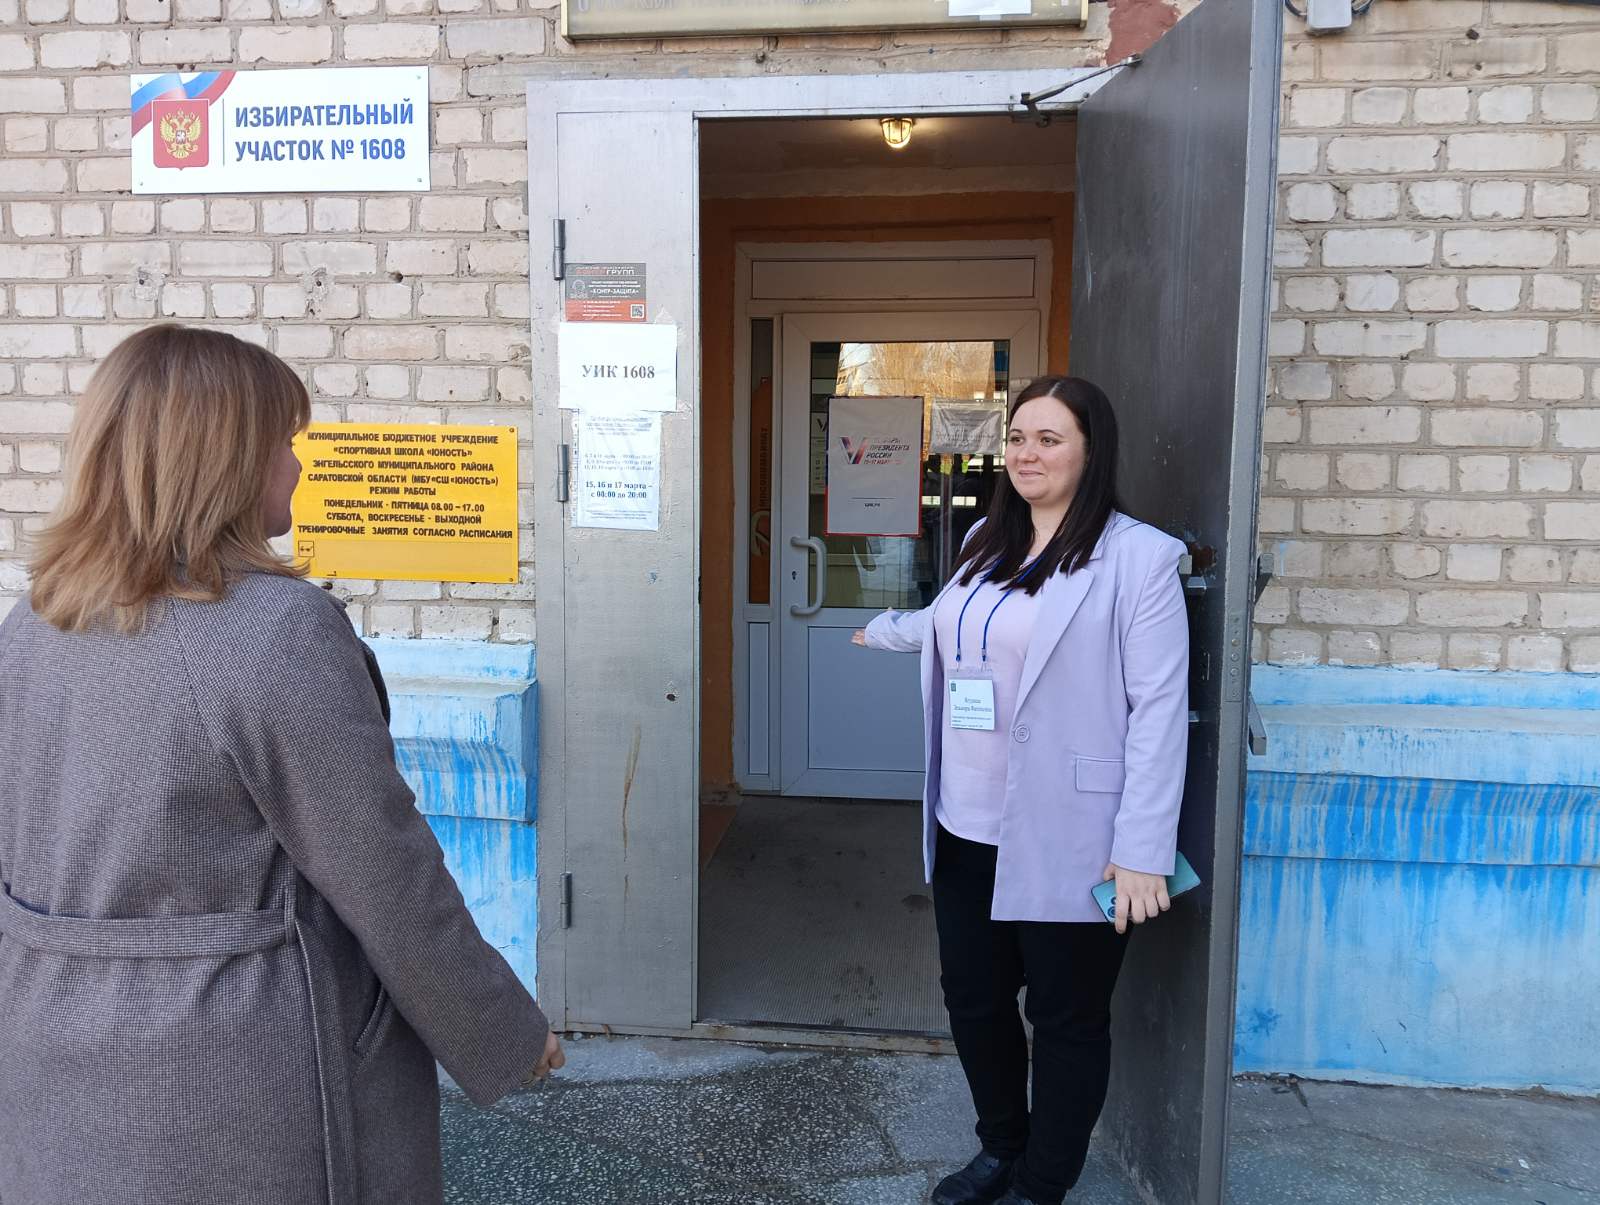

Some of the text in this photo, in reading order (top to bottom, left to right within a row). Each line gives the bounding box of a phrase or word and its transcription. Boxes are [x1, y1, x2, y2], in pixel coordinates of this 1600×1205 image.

[236, 98, 413, 128] ИЗБИРАТЕЛЬНЫЙ
[236, 138, 405, 162] УЧАСТОК № 1608
[582, 365, 655, 378] УИК 1608
[307, 432, 498, 444] МУНИЦИПАЛЬНОЕ БЮДЖЕТНОЕ УЧРЕЖДЕНИЕ
[334, 446, 472, 457] «СПОРТИВНАЯ ШКОЛА «ЮНОСТЬ»
[313, 460, 494, 471] ЭНГЕЛЬССКОГО МУНИЦИПАЛЬНОГО РАЙОНА
[308, 473, 363, 482] САРАТОВСКОЙ
[368, 475, 406, 483] ОБЛАСТИ
[404, 487, 436, 495] РАБОТЫ
[325, 499, 383, 509] ПОНЕДЕЛЬНИК
[392, 501, 428, 511] ПЯТНИЦА
[431, 503, 453, 511] 08.00
[463, 504, 485, 512] 17.00
[327, 512, 364, 523] СУББОТА,
[368, 514, 424, 522] ВОСКРЕСЕНЬЕ
[435, 515, 481, 524] ВЫХОДНОЙ
[298, 525, 512, 538] ТРЕНИРОВОЧНЫЕ ЗАНЯТИЯ СОГЛАСНО РАСПИСАНИЯ
